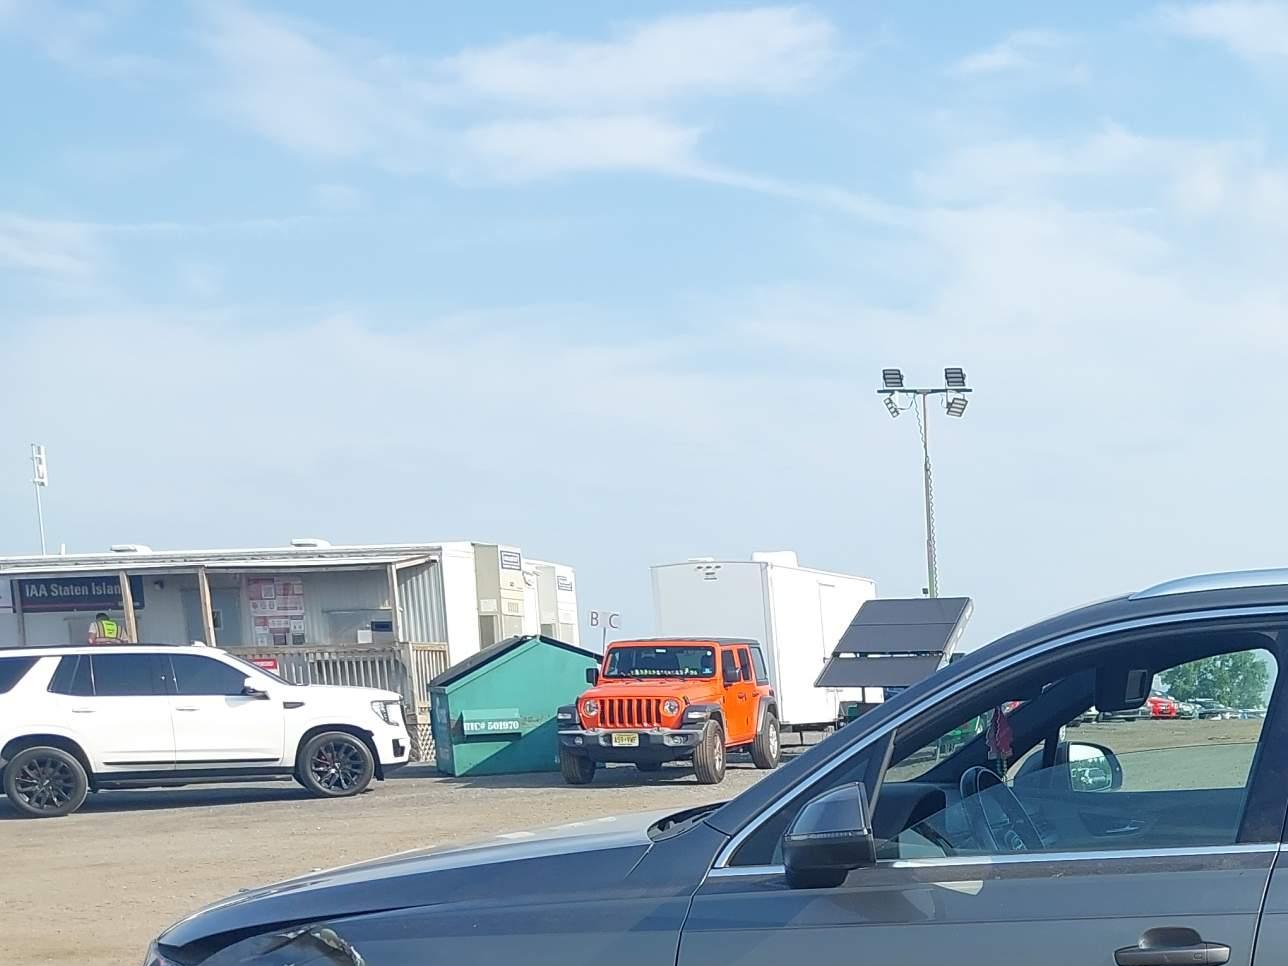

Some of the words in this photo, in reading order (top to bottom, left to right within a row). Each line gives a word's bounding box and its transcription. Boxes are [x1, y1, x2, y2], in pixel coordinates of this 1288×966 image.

[25, 583, 48, 598] IAA
[50, 583, 89, 597] Staten
[92, 581, 122, 595] Islan
[590, 611, 599, 626] B
[609, 613, 620, 629] C
